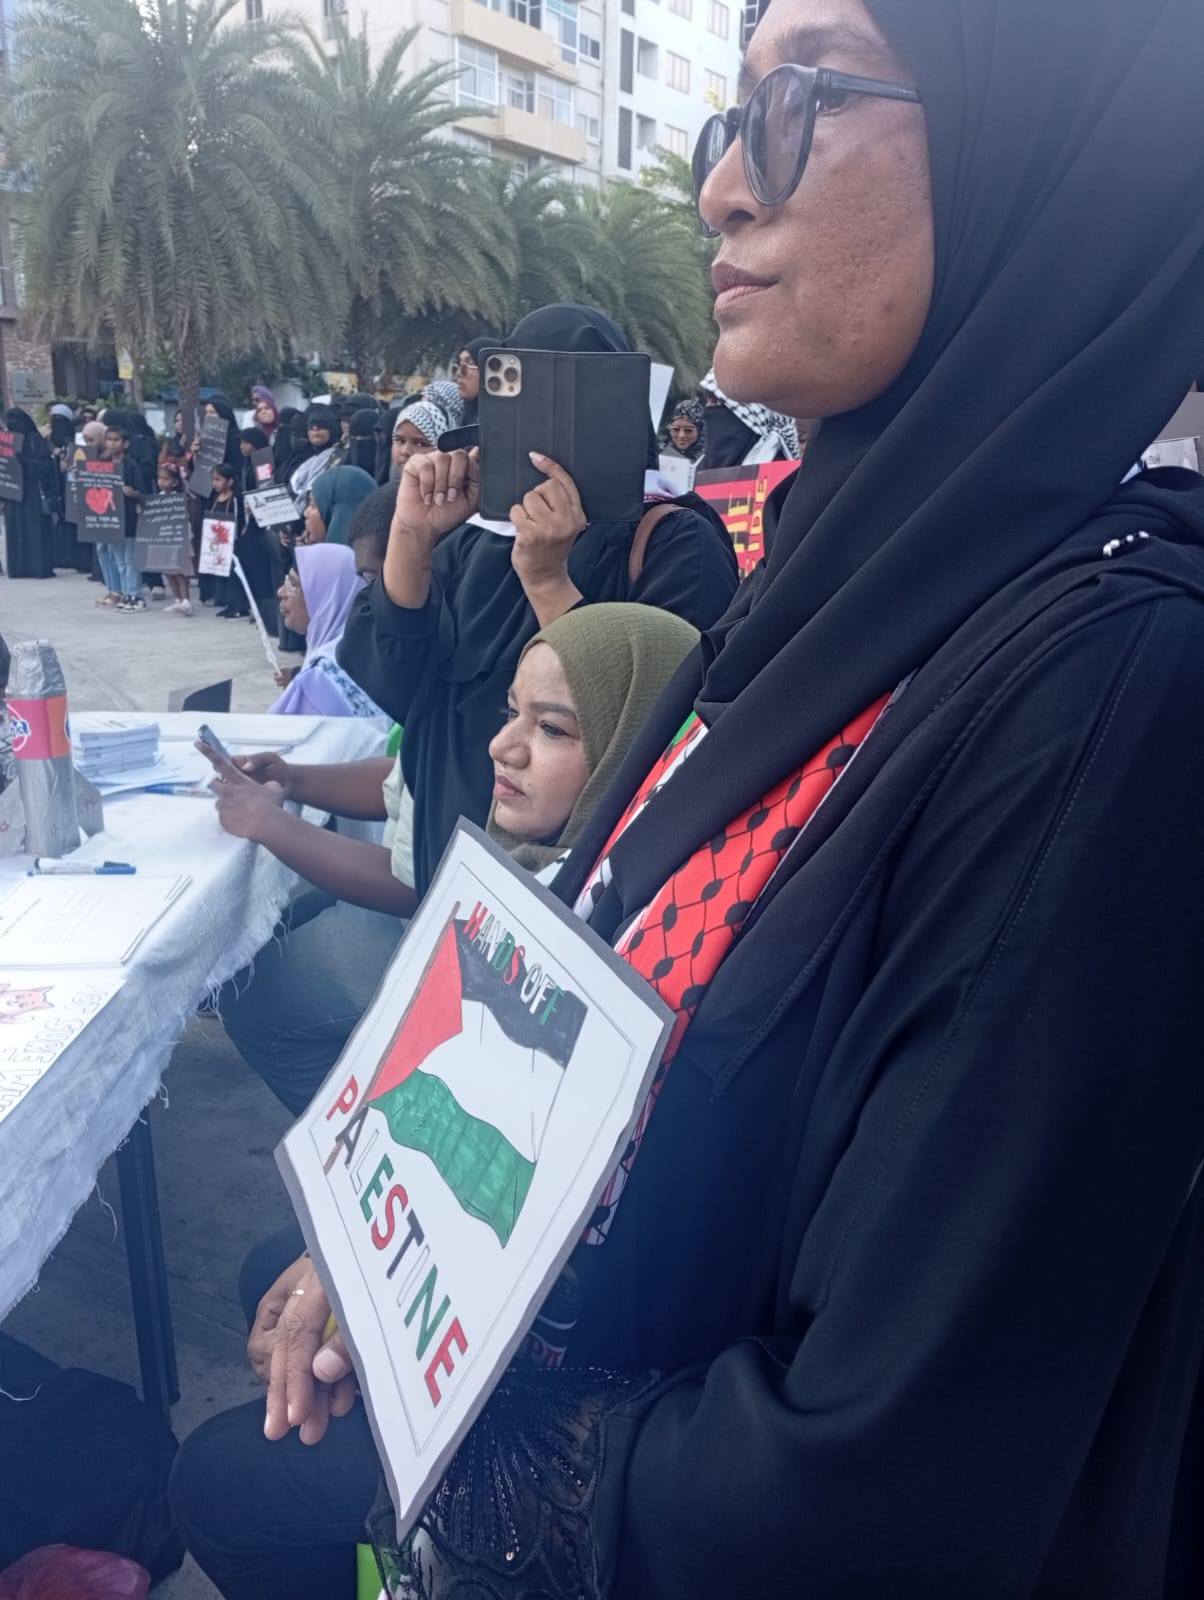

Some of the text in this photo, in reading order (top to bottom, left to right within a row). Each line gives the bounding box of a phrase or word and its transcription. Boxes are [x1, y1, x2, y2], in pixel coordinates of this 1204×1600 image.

[463, 900, 565, 1025] HANDS OFF
[326, 1074, 469, 1408] PALESTINE
